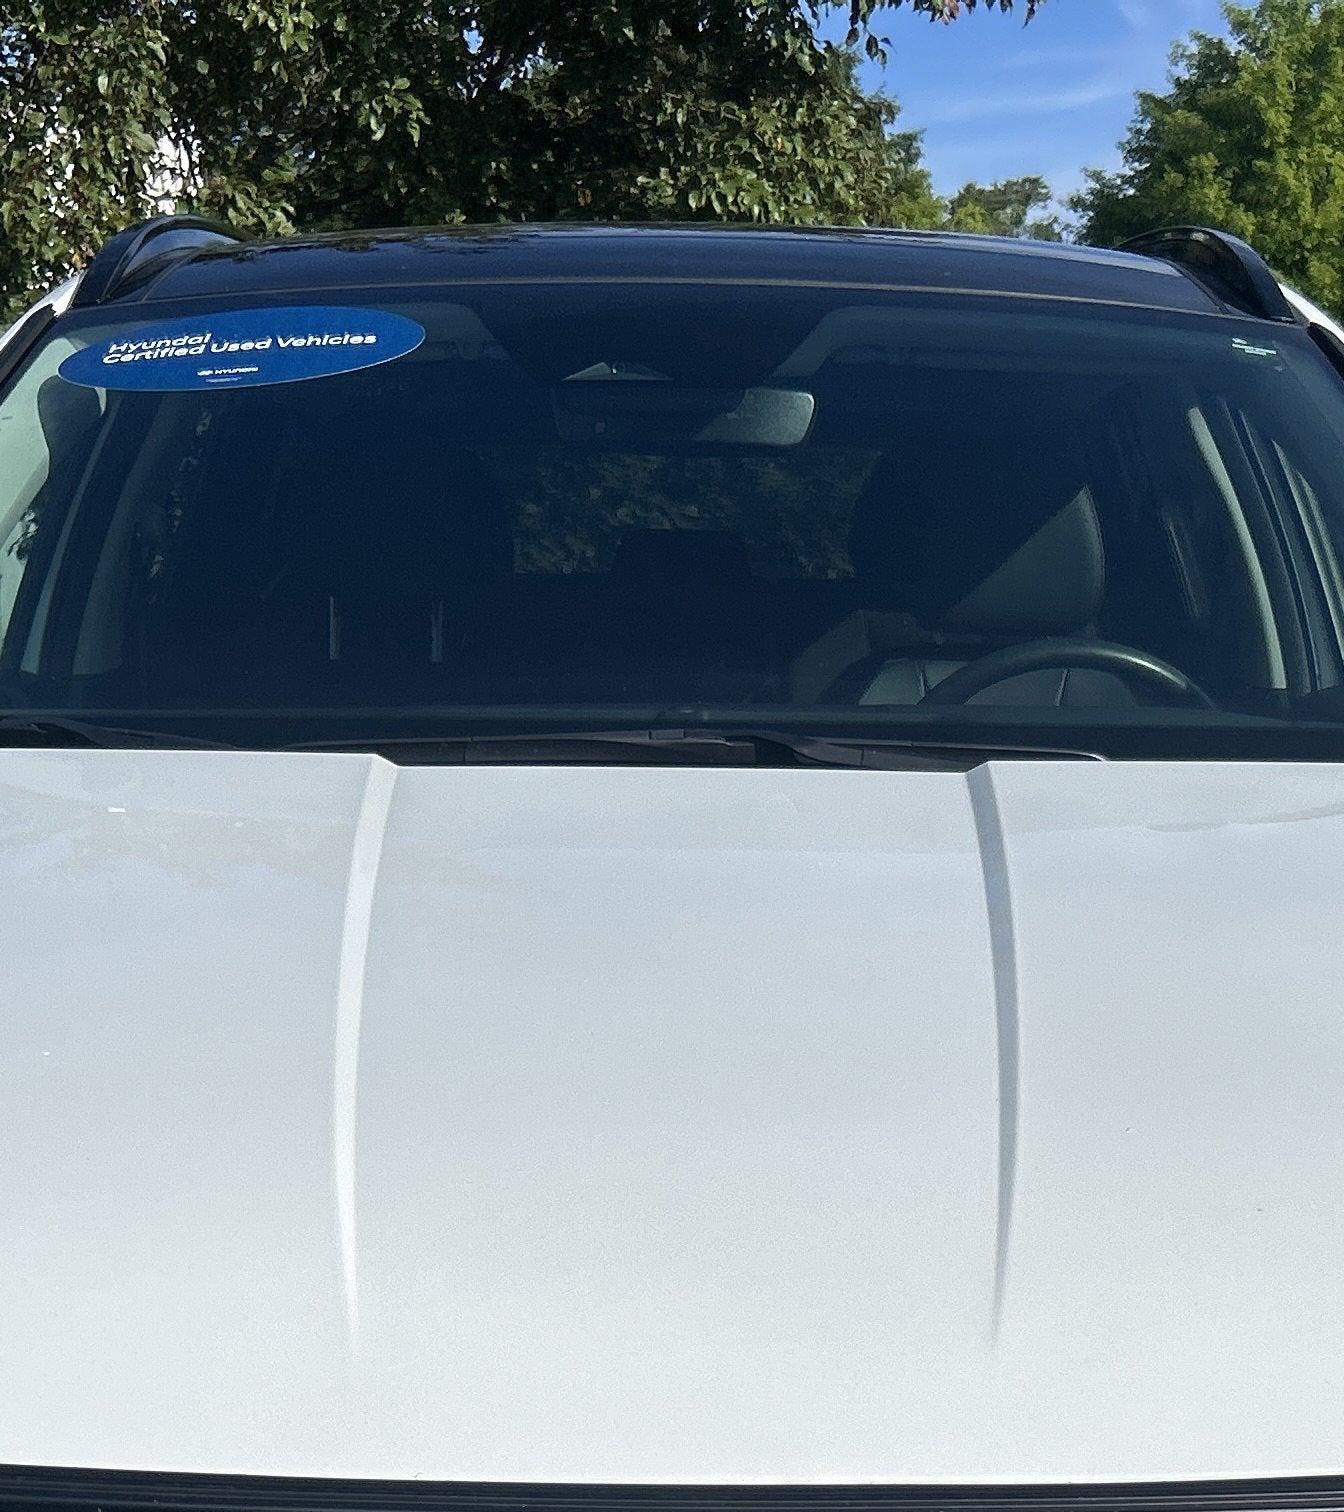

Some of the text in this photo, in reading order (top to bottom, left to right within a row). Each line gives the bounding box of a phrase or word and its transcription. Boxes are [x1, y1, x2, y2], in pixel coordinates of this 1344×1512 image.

[102, 331, 377, 364] Certified Used Vehicles
[109, 332, 212, 353] Hyundai
